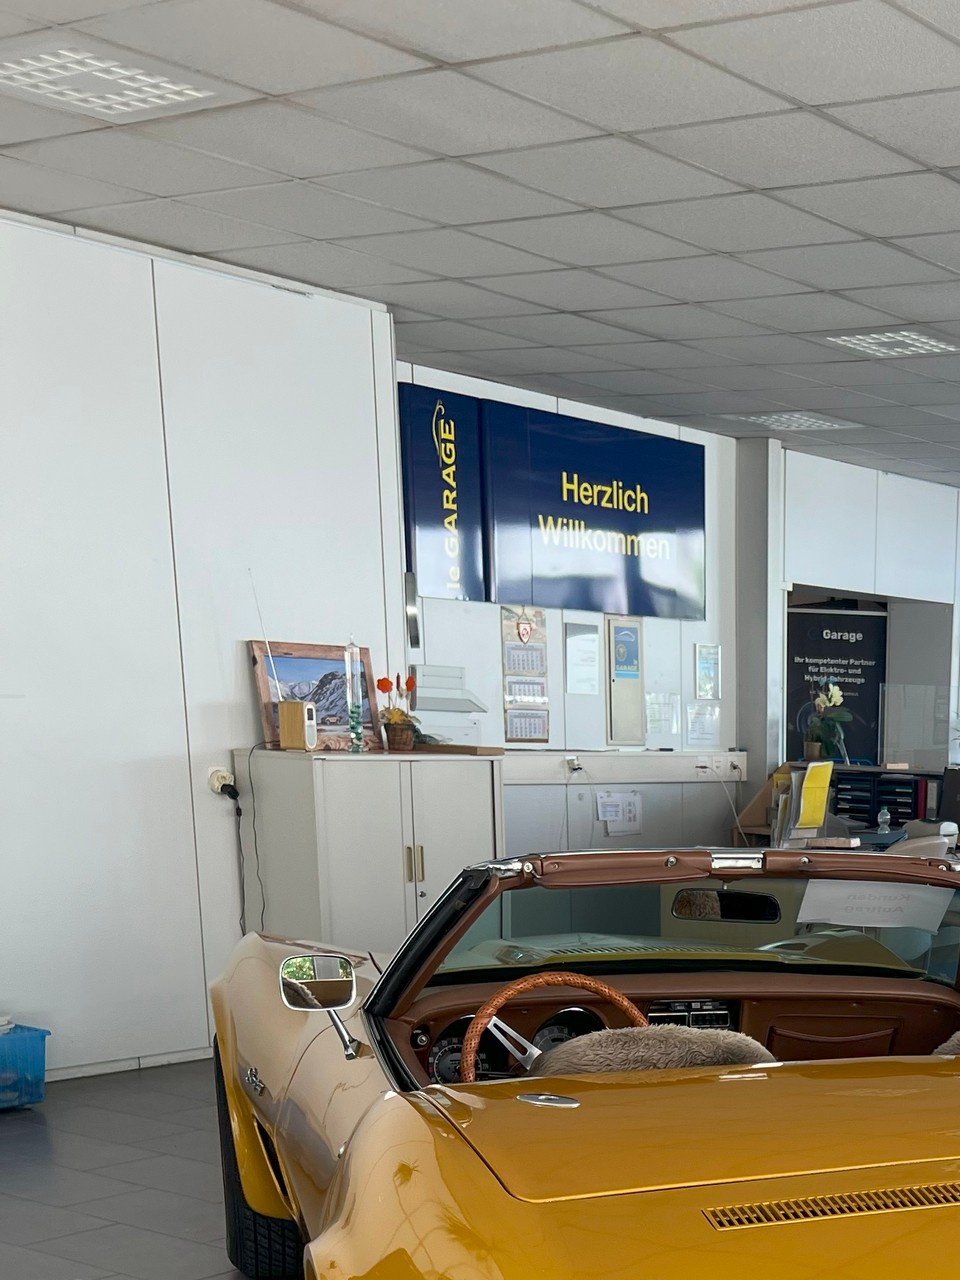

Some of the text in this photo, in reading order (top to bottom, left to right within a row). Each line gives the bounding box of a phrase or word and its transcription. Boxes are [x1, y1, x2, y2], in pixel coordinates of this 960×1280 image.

[440, 418, 459, 559] GARAGE
[561, 471, 648, 514] Herzlich
[538, 514, 670, 560] Willkommen
[822, 629, 863, 643] Garage
[794, 656, 804, 664] Ihr
[805, 657, 849, 665] kompetenter
[808, 665, 819, 673] für
[819, 666, 847, 674] Elektro-
